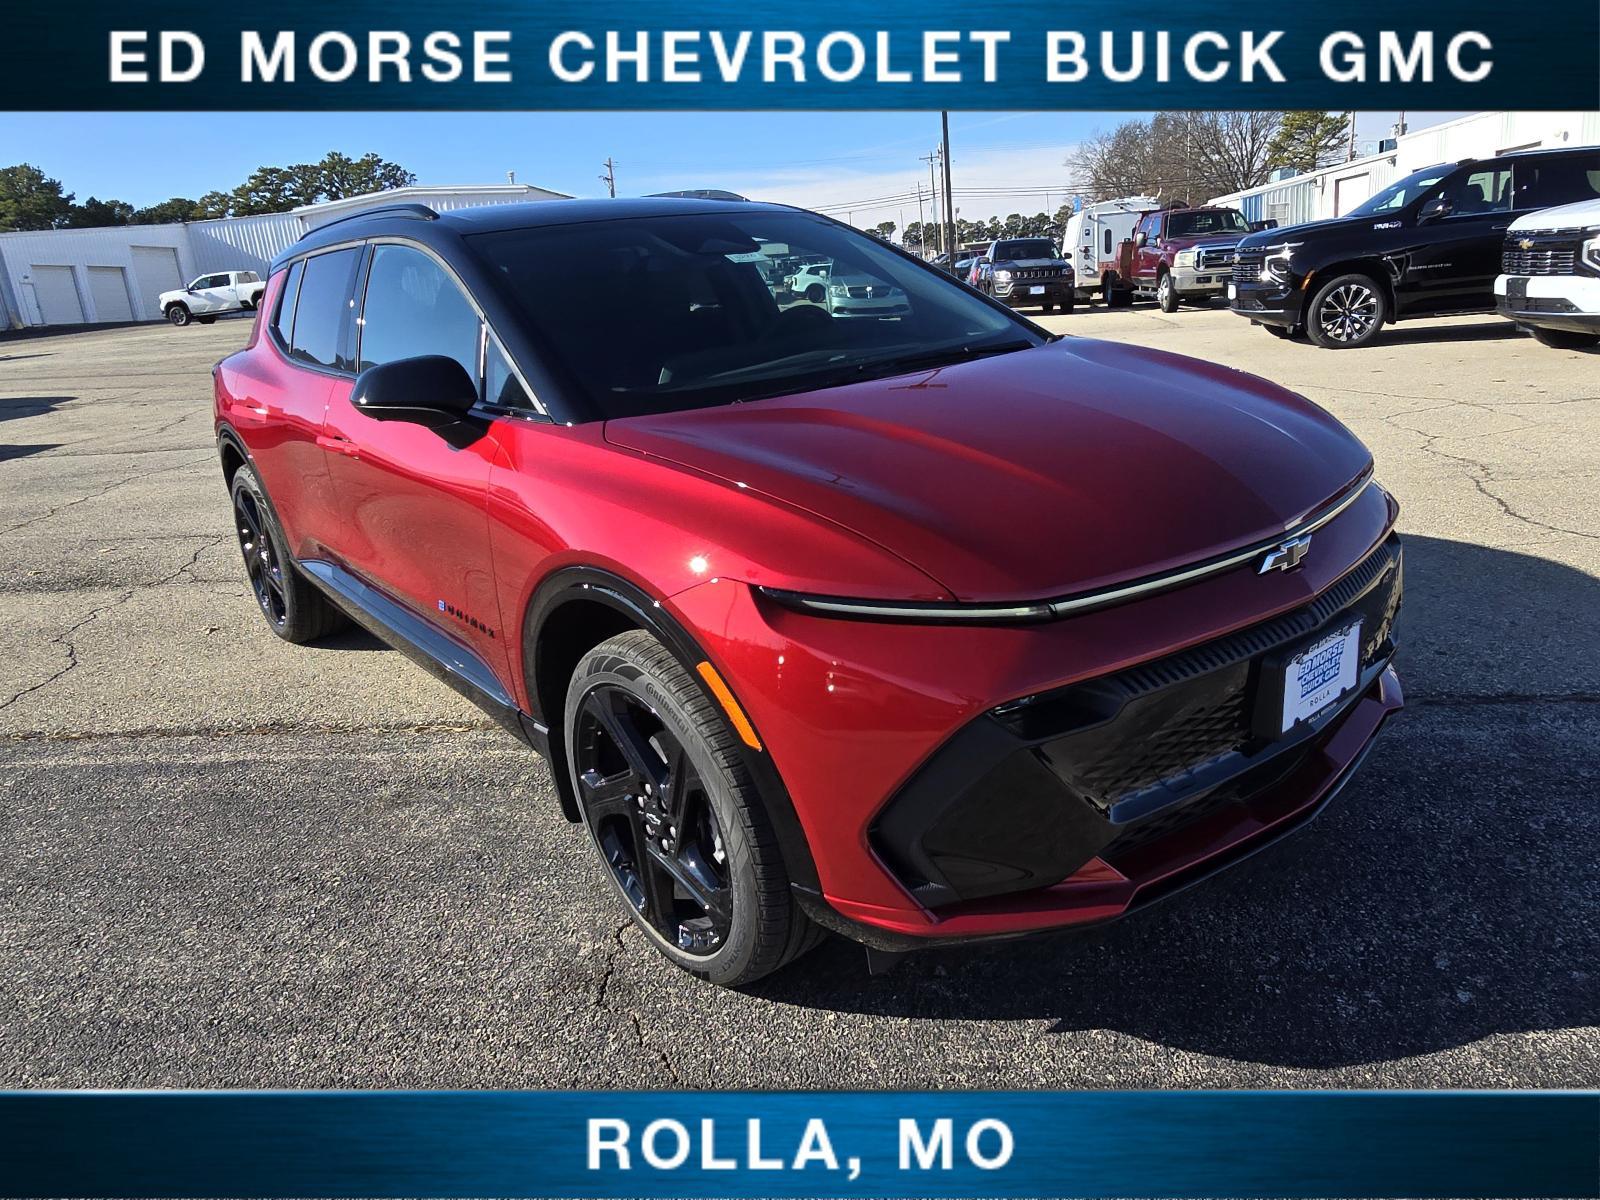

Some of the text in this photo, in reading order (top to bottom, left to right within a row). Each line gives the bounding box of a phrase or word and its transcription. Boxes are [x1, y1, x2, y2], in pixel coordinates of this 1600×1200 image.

[1300, 642, 1344, 675] ED MORSE
[1301, 655, 1340, 685] CHEVROLET
[645, 682, 689, 734] Continental
[1309, 689, 1330, 706] ROLLA
